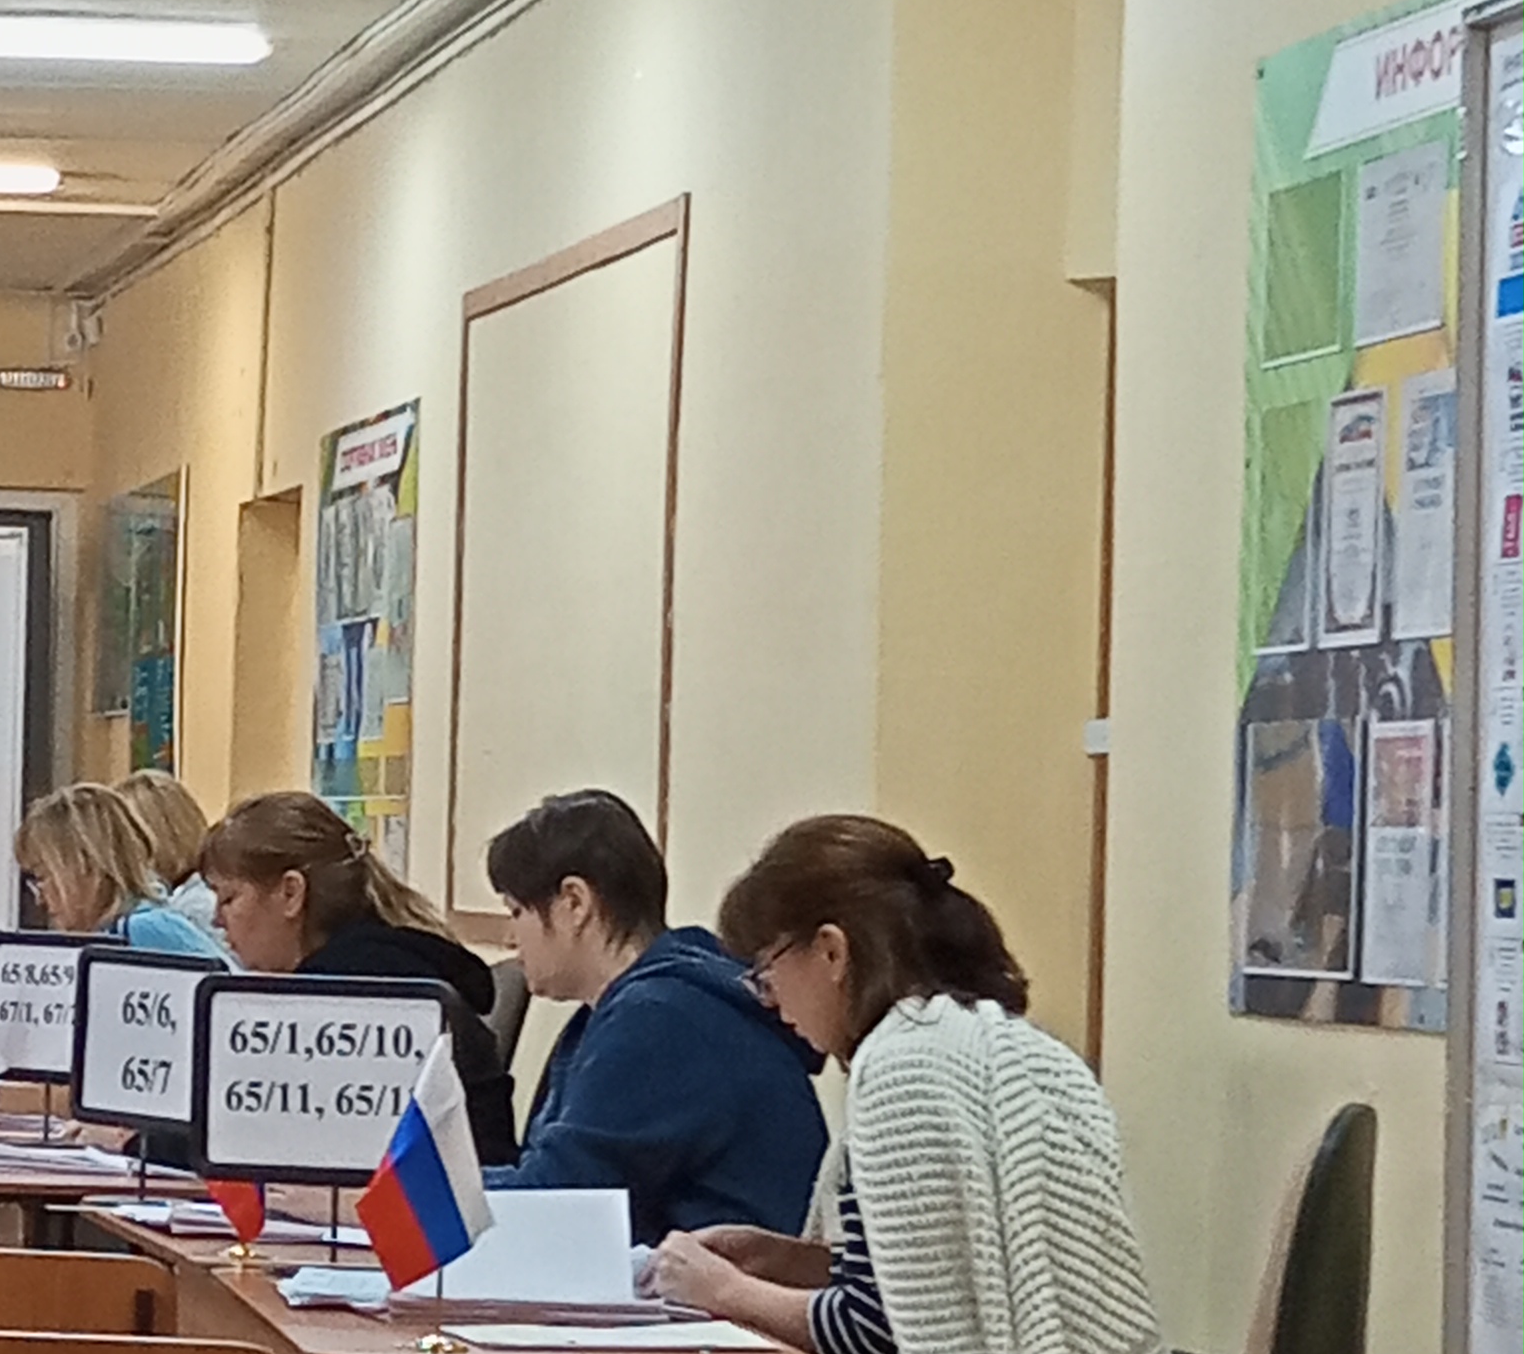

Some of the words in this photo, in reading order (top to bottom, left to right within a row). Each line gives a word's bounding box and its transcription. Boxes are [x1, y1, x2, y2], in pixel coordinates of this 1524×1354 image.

[1375, 27, 1466, 101] ИНФОР
[122, 991, 177, 1034] 65/6,
[229, 1019, 425, 1065] 65/1,65/10,
[121, 1055, 173, 1095] 65/7
[226, 1080, 326, 1121] 65/11,
[335, 1083, 414, 1117] 65/1
